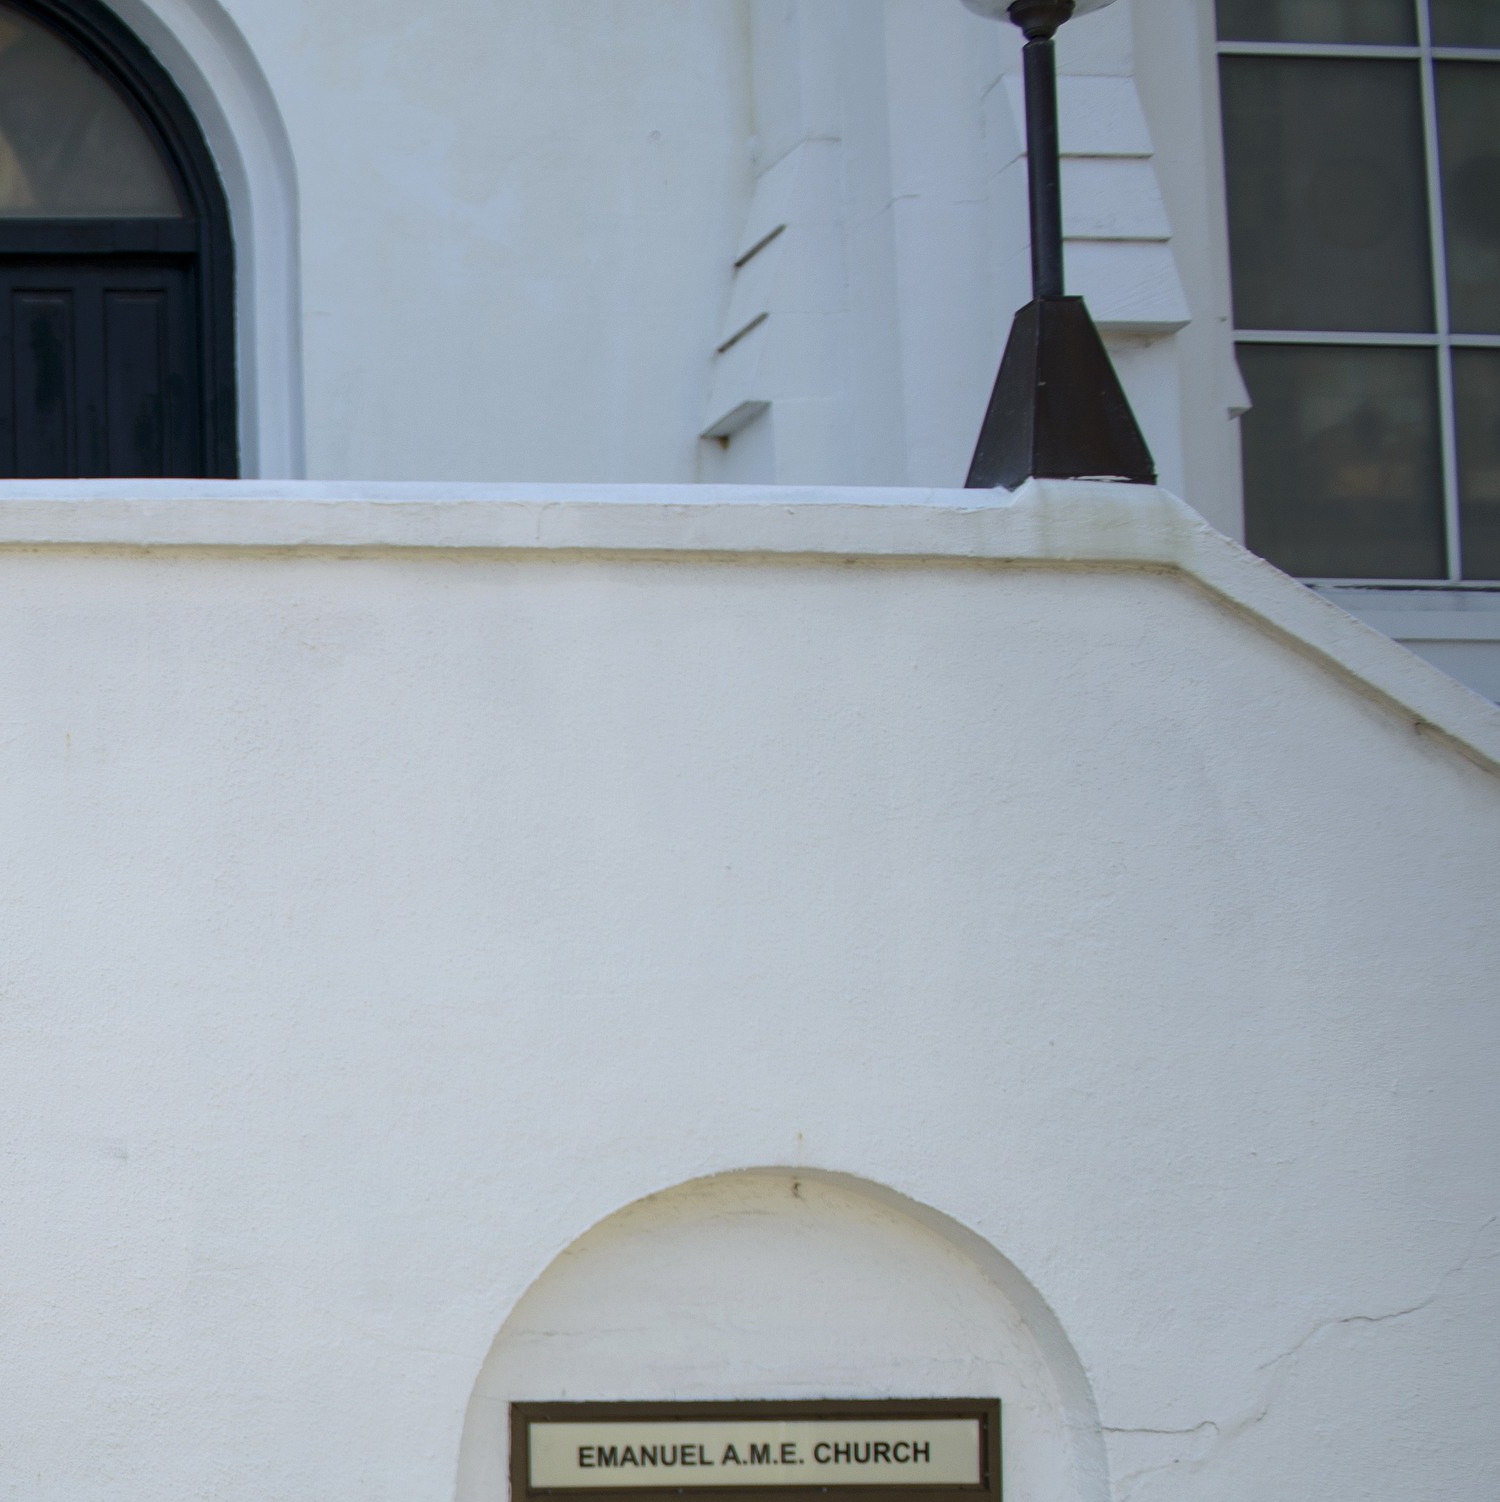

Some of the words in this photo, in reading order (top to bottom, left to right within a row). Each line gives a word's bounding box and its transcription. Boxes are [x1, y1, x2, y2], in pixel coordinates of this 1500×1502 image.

[577, 1443, 715, 1468] EMANUEL
[720, 1442, 806, 1467] A.M.E.
[813, 1440, 931, 1465] CHURCH
